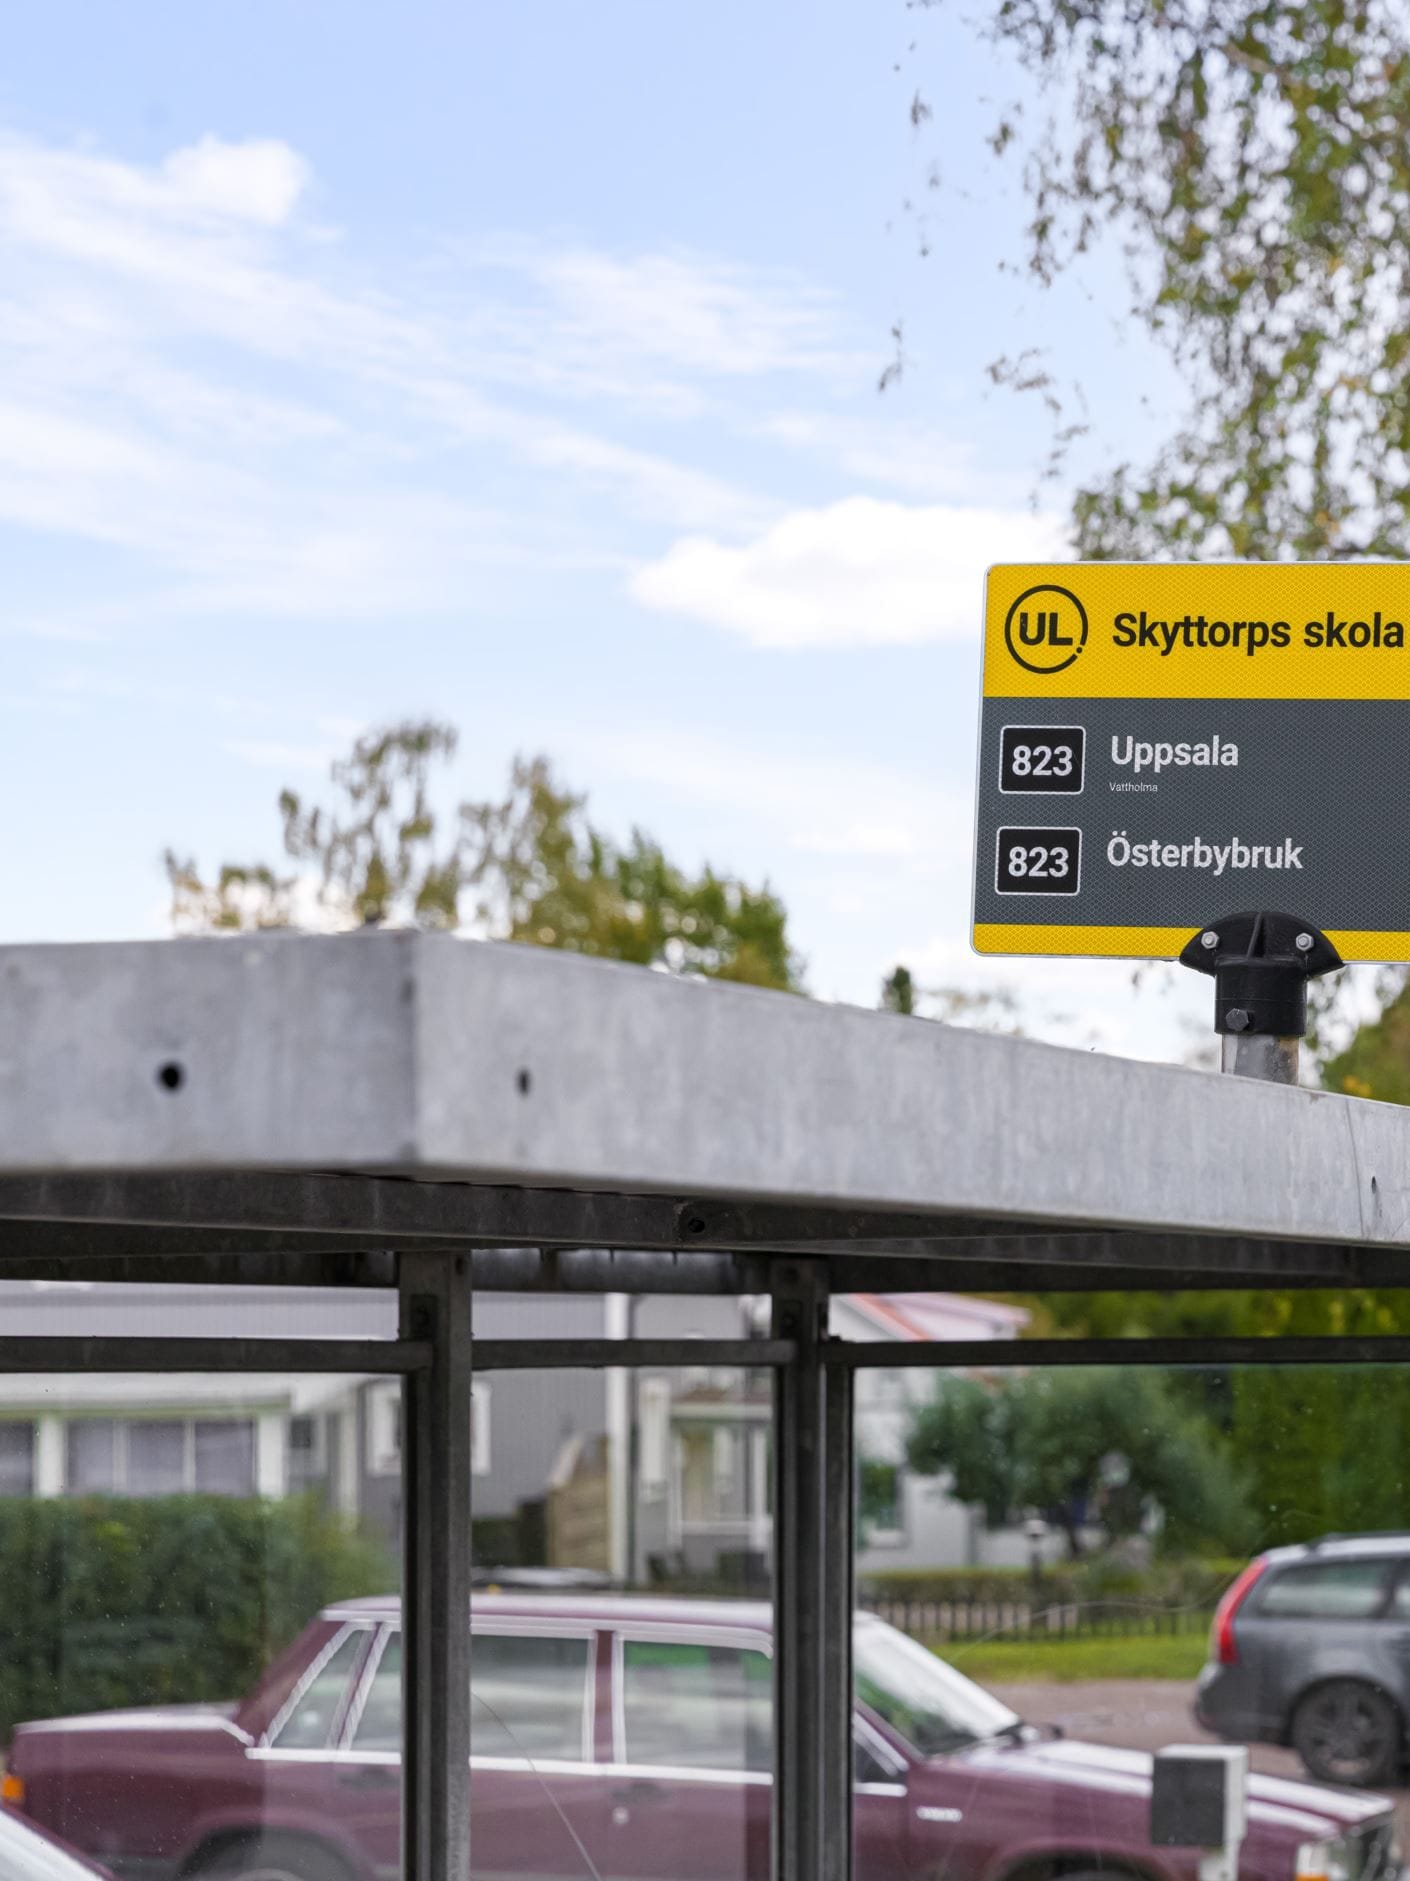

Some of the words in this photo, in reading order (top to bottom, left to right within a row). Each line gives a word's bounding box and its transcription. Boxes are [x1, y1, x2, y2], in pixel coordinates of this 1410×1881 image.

[1019, 612, 1074, 646] UL
[1112, 611, 1291, 657] Skyttorps
[1303, 611, 1404, 648] skola
[1012, 745, 1073, 776] 823
[1110, 734, 1239, 773] Uppsala
[1108, 781, 1158, 792] Vattholma
[1008, 846, 1069, 877] 823
[1107, 830, 1304, 876] Österbybruk
